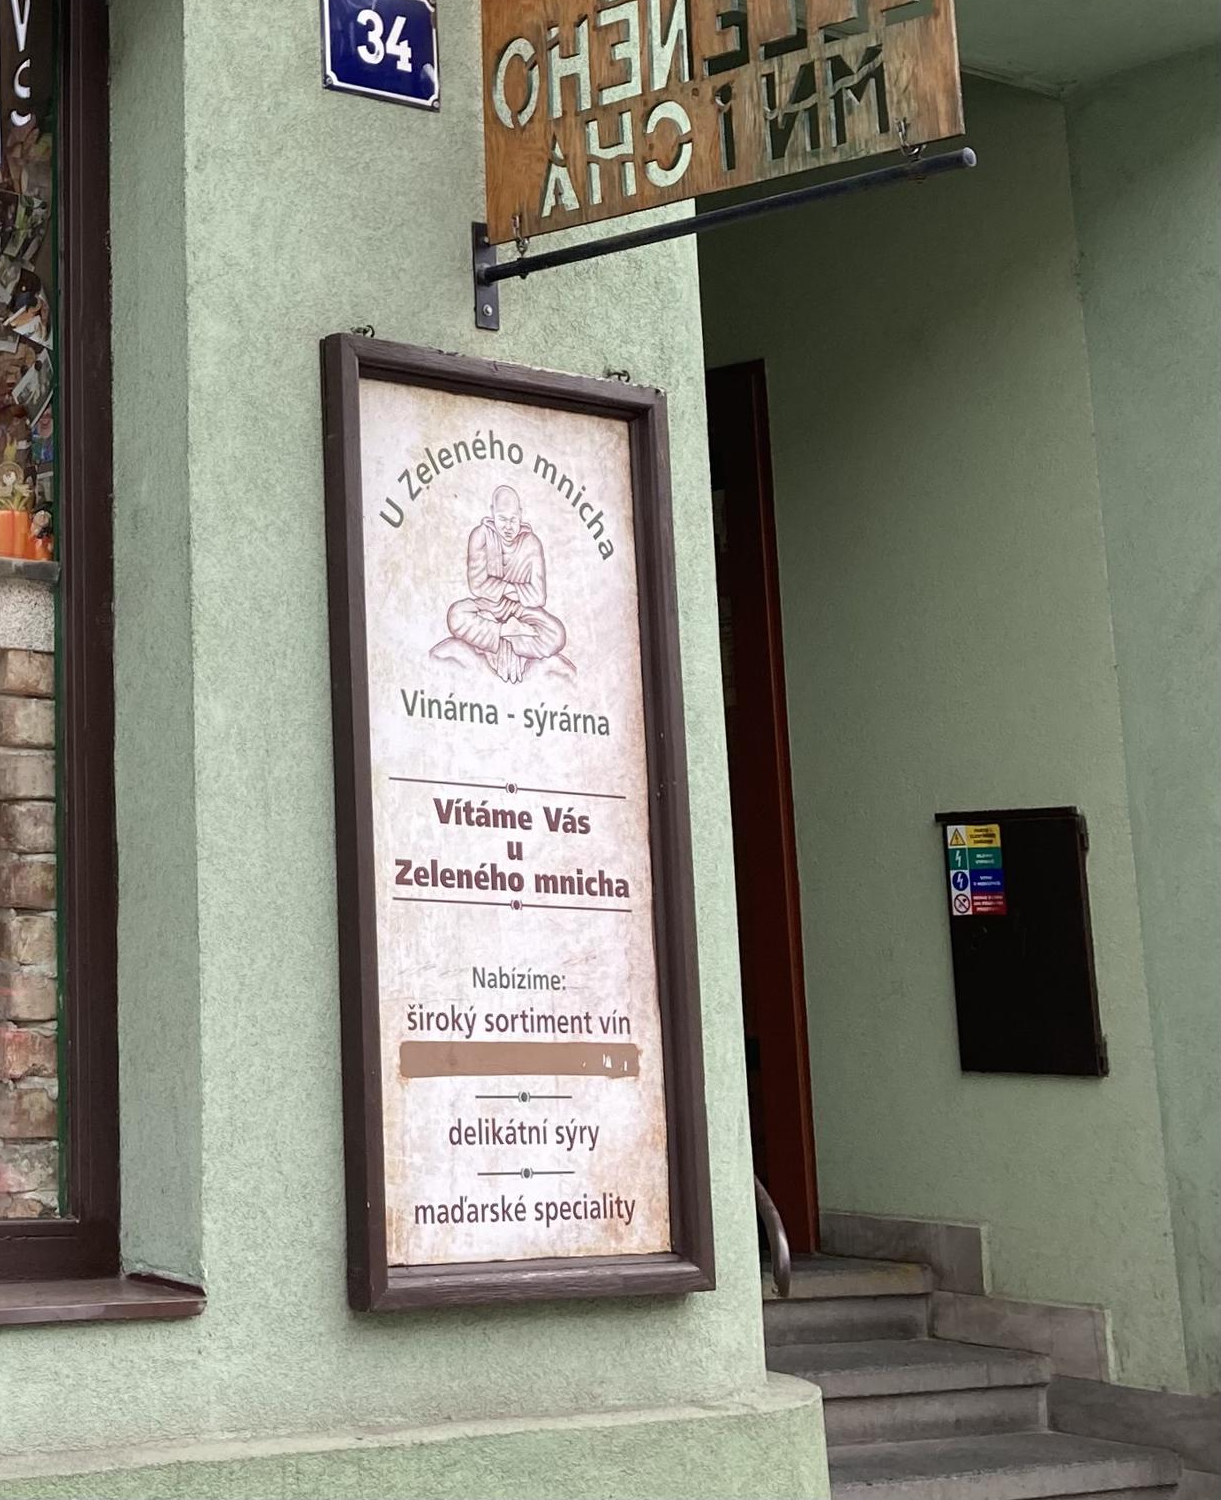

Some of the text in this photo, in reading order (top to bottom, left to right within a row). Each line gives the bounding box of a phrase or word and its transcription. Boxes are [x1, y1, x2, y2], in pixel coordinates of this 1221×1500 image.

[357, 9, 412, 74] 34
[379, 430, 614, 561] U Zeleného mnicha
[401, 689, 499, 725] Vinárna
[523, 702, 610, 737] sýrárna
[433, 798, 591, 834] Vítáme Vás
[507, 841, 523, 860] u
[395, 858, 630, 898] Zeleného mnicha
[472, 967, 566, 990] Nabízíme:
[407, 1004, 630, 1039] široký sortiment vín
[449, 1118, 599, 1151] delikátní sýry
[414, 1193, 636, 1228] maďarské speciality
